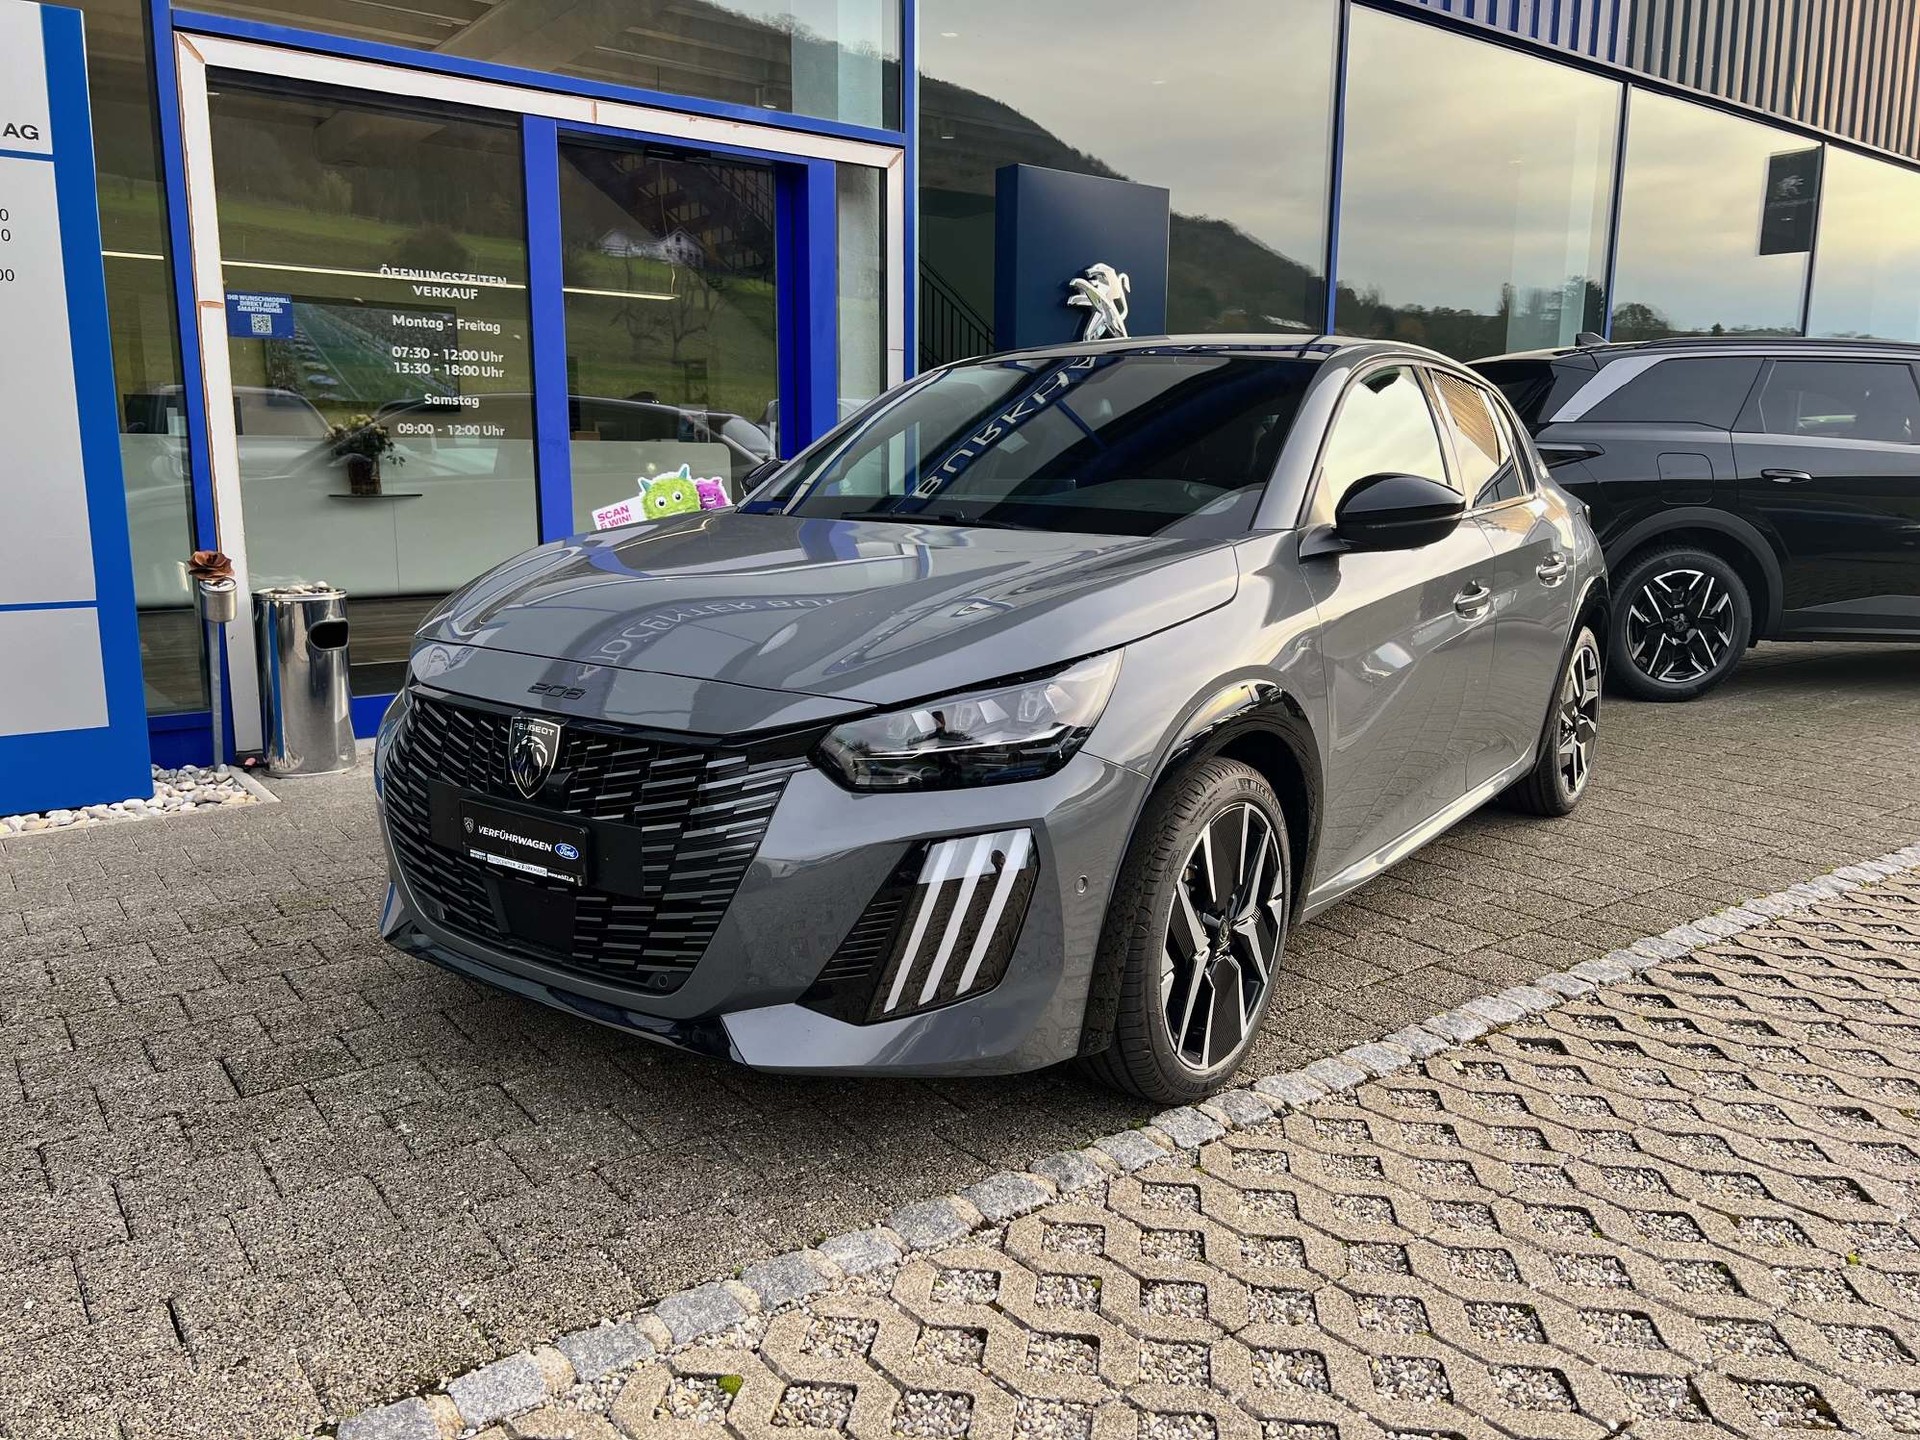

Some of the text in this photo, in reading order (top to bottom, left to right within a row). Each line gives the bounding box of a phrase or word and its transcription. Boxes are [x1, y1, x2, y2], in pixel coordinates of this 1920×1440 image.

[3, 122, 39, 141] AG
[379, 263, 507, 286] ÖFFNUNGSZEITEN
[412, 285, 478, 300] VERKAUF
[392, 314, 444, 331] Montag
[456, 318, 501, 335] Freitag
[391, 346, 430, 359] 07:30
[443, 349, 479, 361] 12:00
[480, 351, 504, 363] Uhr
[394, 362, 431, 375] 13:30
[444, 364, 480, 376] 18:00
[481, 366, 505, 378] Uhr
[424, 393, 480, 409] Samstag
[397, 423, 434, 434] 09:00
[447, 424, 480, 436] 12:00
[482, 425, 505, 436] Uhr
[597, 505, 630, 522] SCAN
[608, 514, 632, 527] WIN!
[527, 682, 587, 700] 208
[513, 722, 555, 737] PEUGEOT
[478, 825, 553, 852] VERFÜHRWAGEN
